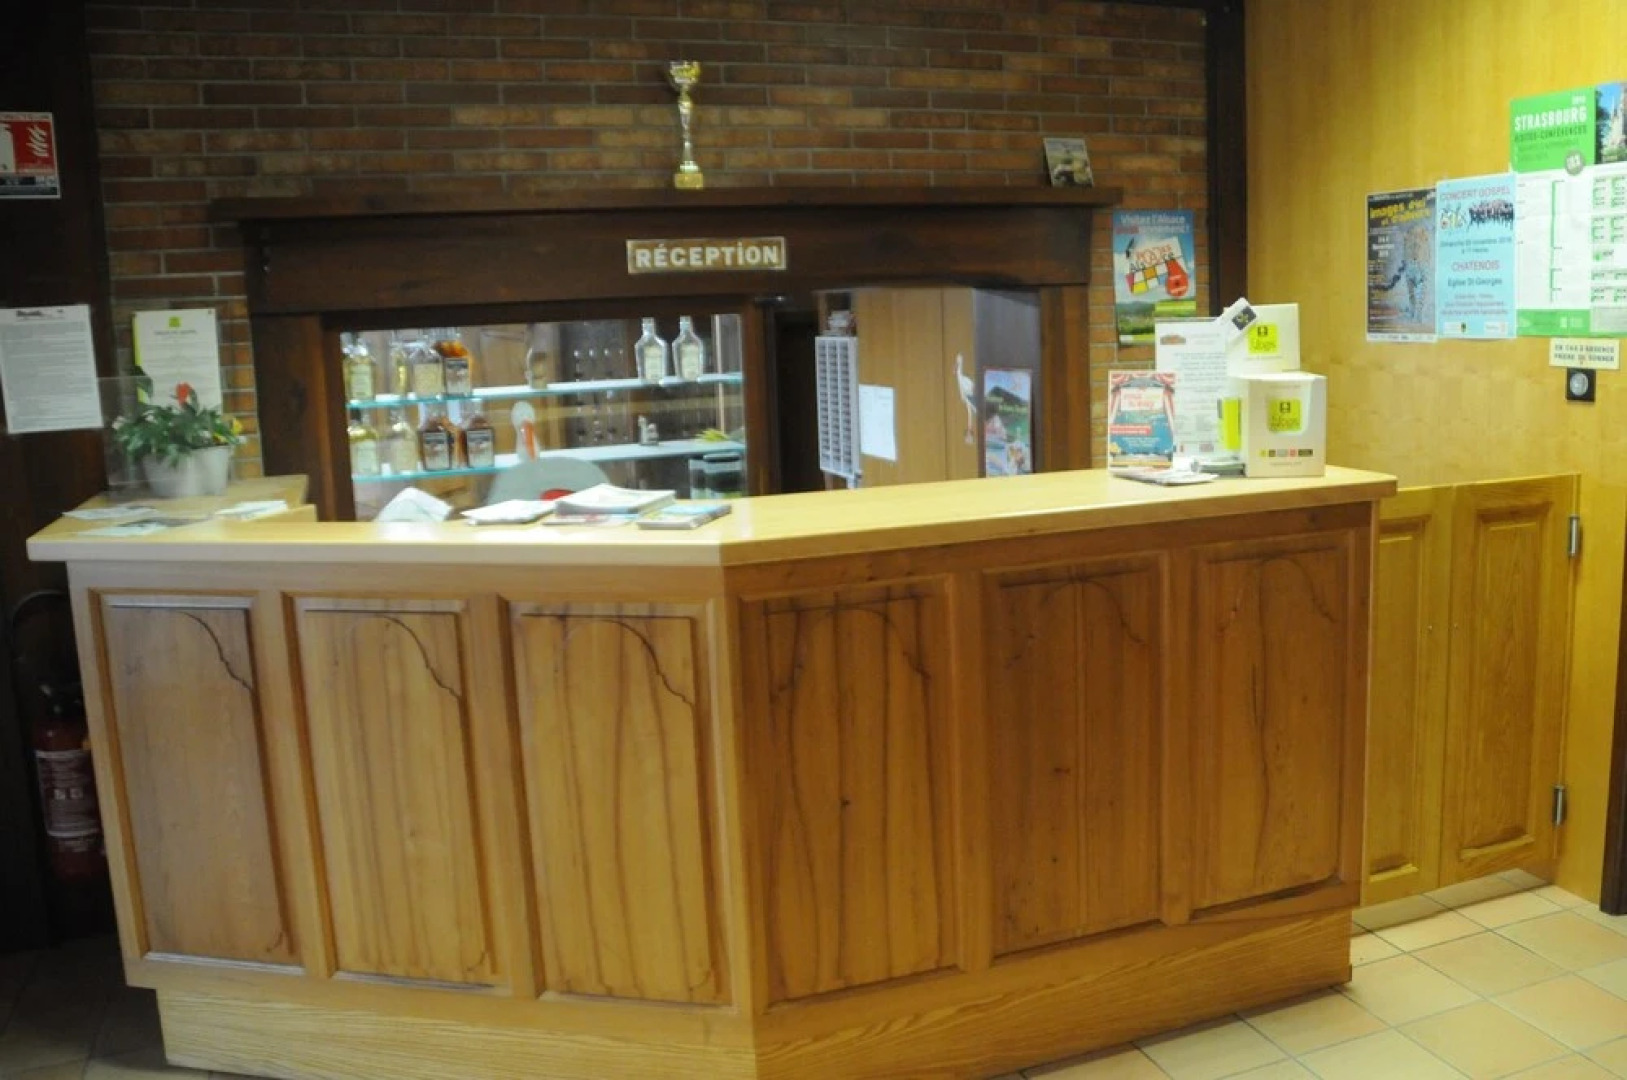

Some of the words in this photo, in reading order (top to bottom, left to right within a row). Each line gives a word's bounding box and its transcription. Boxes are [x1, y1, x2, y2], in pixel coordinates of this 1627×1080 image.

[1514, 106, 1587, 131] STRASBOURG
[1440, 188, 1476, 201] CONCERT
[1479, 185, 1511, 197] GOSPEL
[1451, 260, 1500, 272] CHATENOIS
[1476, 276, 1503, 287] Georges
